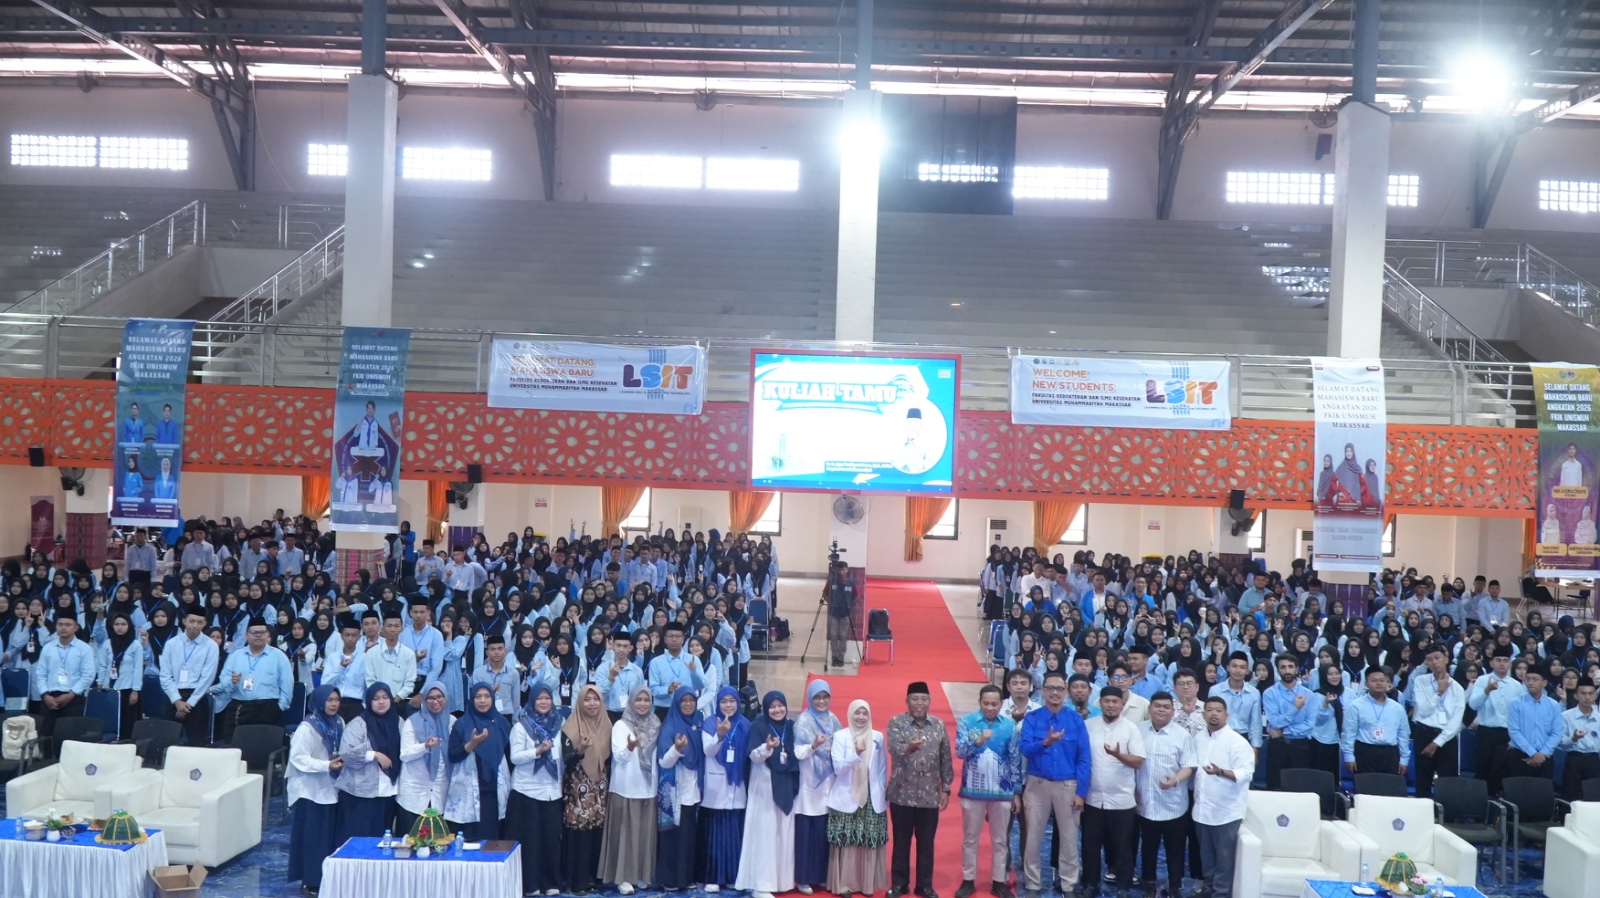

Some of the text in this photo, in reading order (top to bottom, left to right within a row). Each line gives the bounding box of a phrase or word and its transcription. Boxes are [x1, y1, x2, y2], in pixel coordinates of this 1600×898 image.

[126, 345, 166, 353] MAHASISWA
[128, 354, 163, 362] ANGKATAN
[558, 357, 594, 366] DATANG
[569, 368, 593, 377] BARU
[623, 364, 694, 389] LSIT
[1033, 368, 1088, 378] WELCOME
[1032, 381, 1114, 391] NEW STUDENTS
[1544, 383, 1590, 392] SELAMAT DATANG
[762, 381, 898, 404] KULIAH TAMU
[1146, 379, 1218, 405] LSIT
[1544, 393, 1593, 402] MAHASISWA BARU
[1547, 403, 1592, 412] ANGKATAN 2026
[1551, 413, 1590, 422] FKIK UNISMUH
[1557, 423, 1588, 432] MAKASSAR
